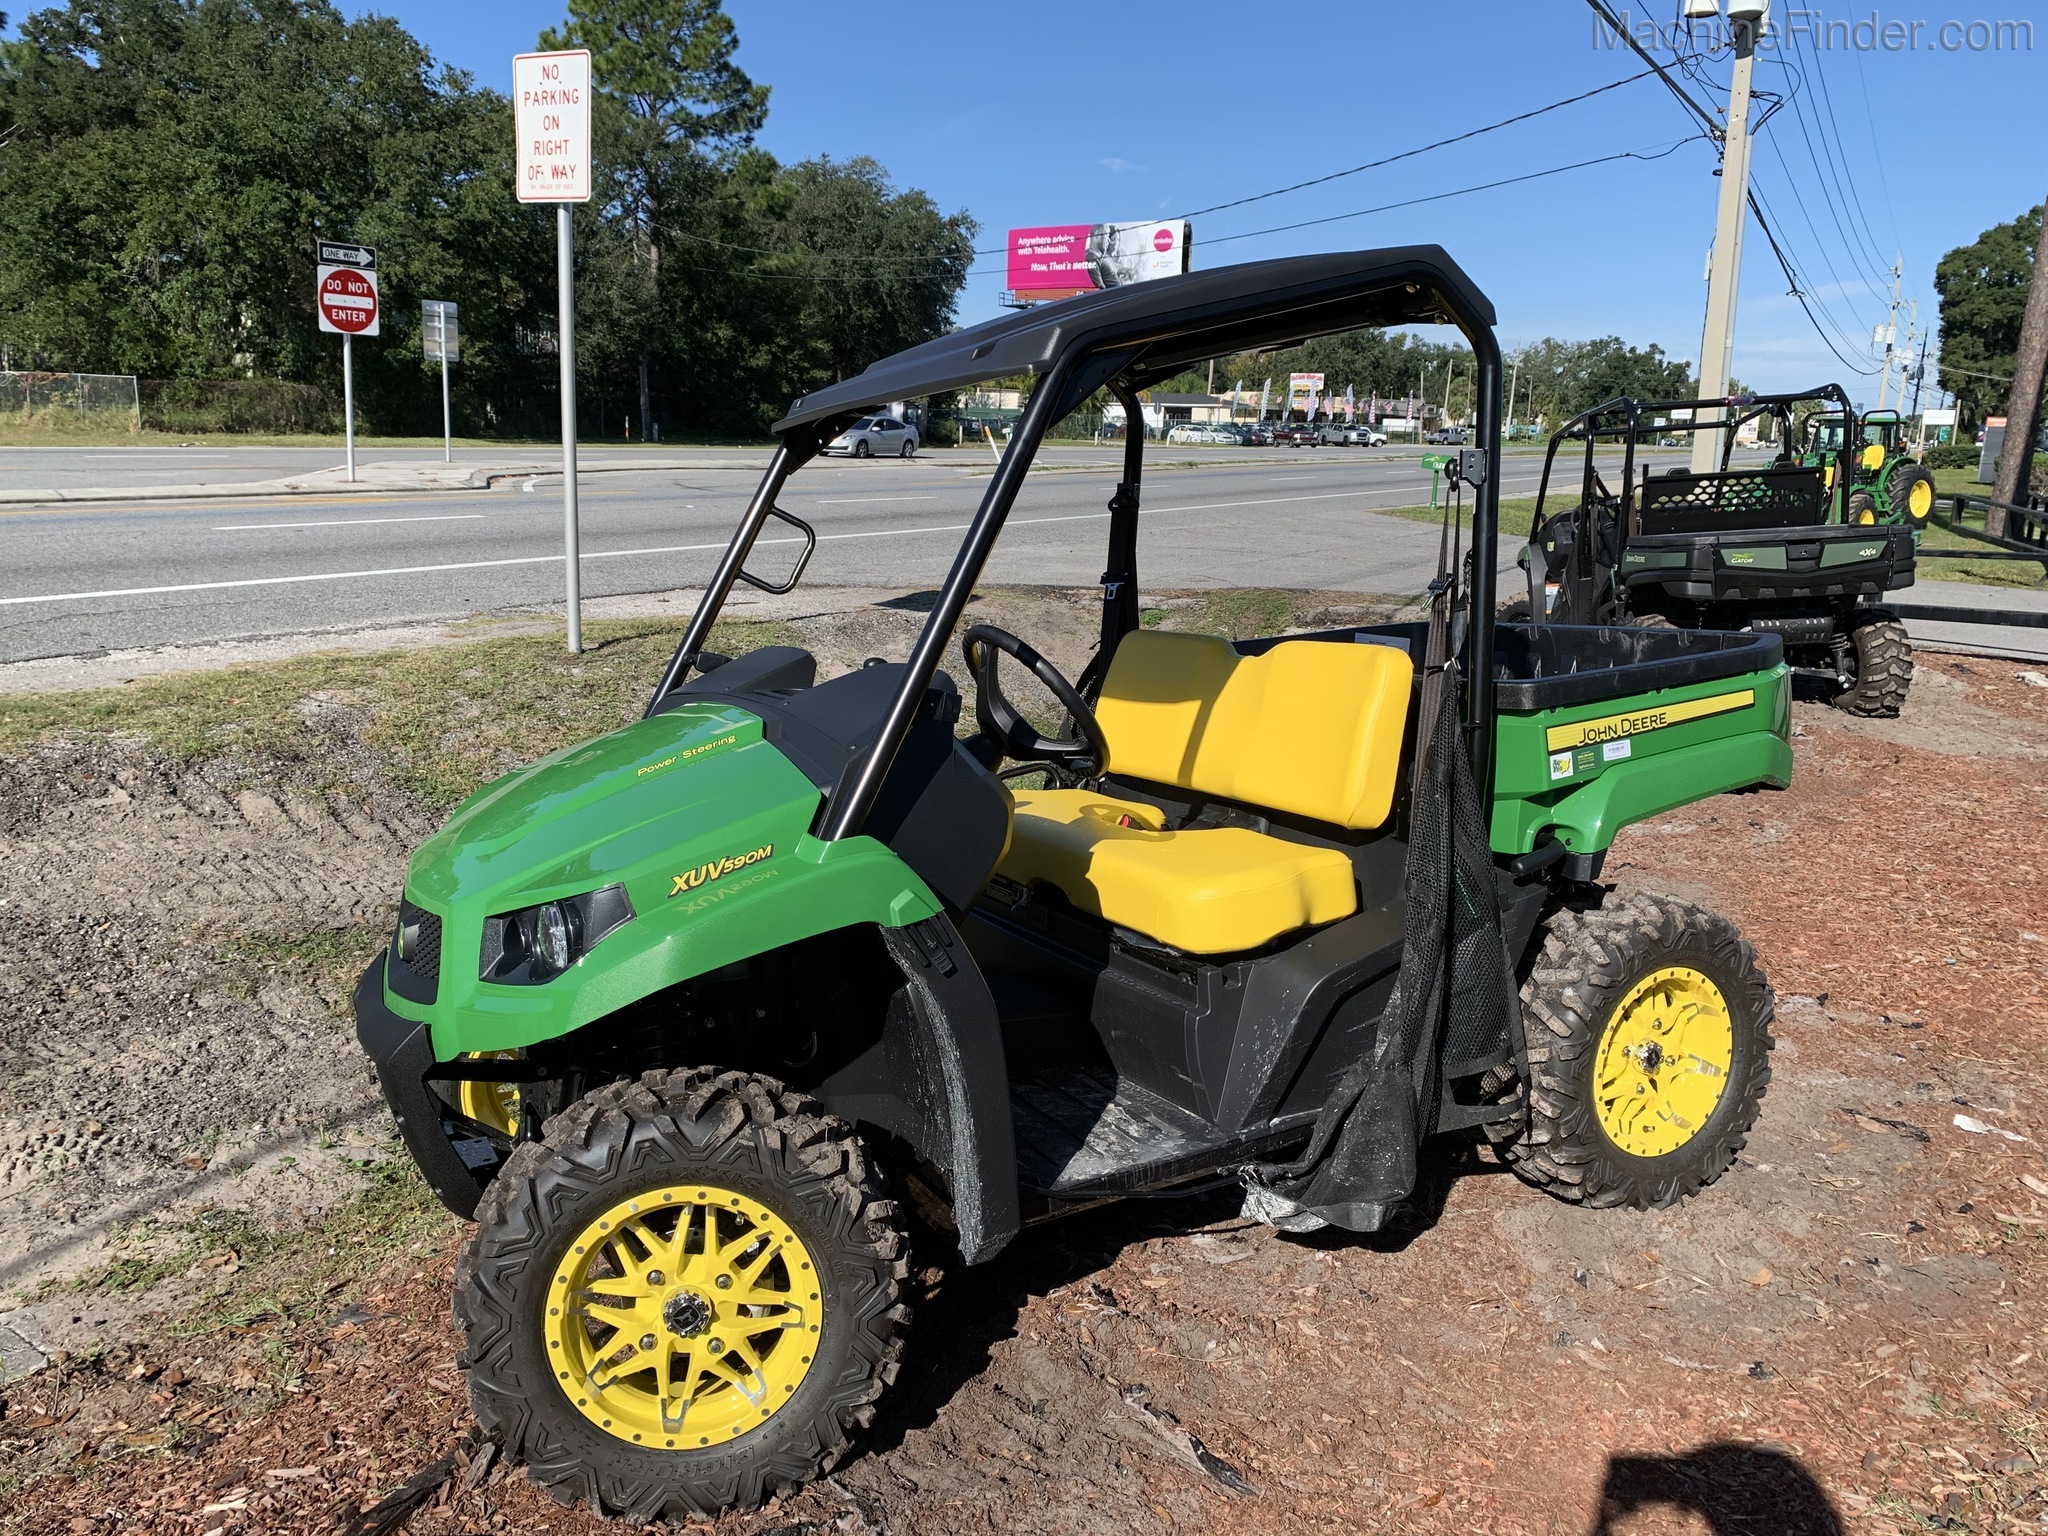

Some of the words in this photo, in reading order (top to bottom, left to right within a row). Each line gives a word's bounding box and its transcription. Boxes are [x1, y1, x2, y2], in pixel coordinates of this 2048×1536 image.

[542, 64, 559, 80] NO
[524, 88, 579, 107] PARKING
[543, 115, 559, 130] ON
[534, 140, 569, 156] RIGHT
[528, 165, 542, 180] OF
[551, 164, 576, 180] WAY
[1018, 236, 1051, 246] Anywhere
[1052, 234, 1074, 243] advice
[325, 248, 340, 258] ONE
[343, 251, 359, 260] WAY
[1018, 247, 1032, 255] with
[1034, 245, 1070, 255] Telehealth.
[1031, 263, 1048, 272] Now,
[1049, 262, 1071, 270] That's
[327, 279, 342, 290] DO
[348, 281, 368, 294] NOT
[332, 309, 366, 322] ENTER
[1579, 723, 1618, 744] JOHN
[1621, 712, 1667, 733] DEERE
[637, 756, 678, 777] Power
[682, 734, 737, 760] Steering
[667, 844, 774, 898] XUV590M
[620, 1165, 763, 1194] MAXXIS
[607, 1444, 754, 1479] BIGHORN
